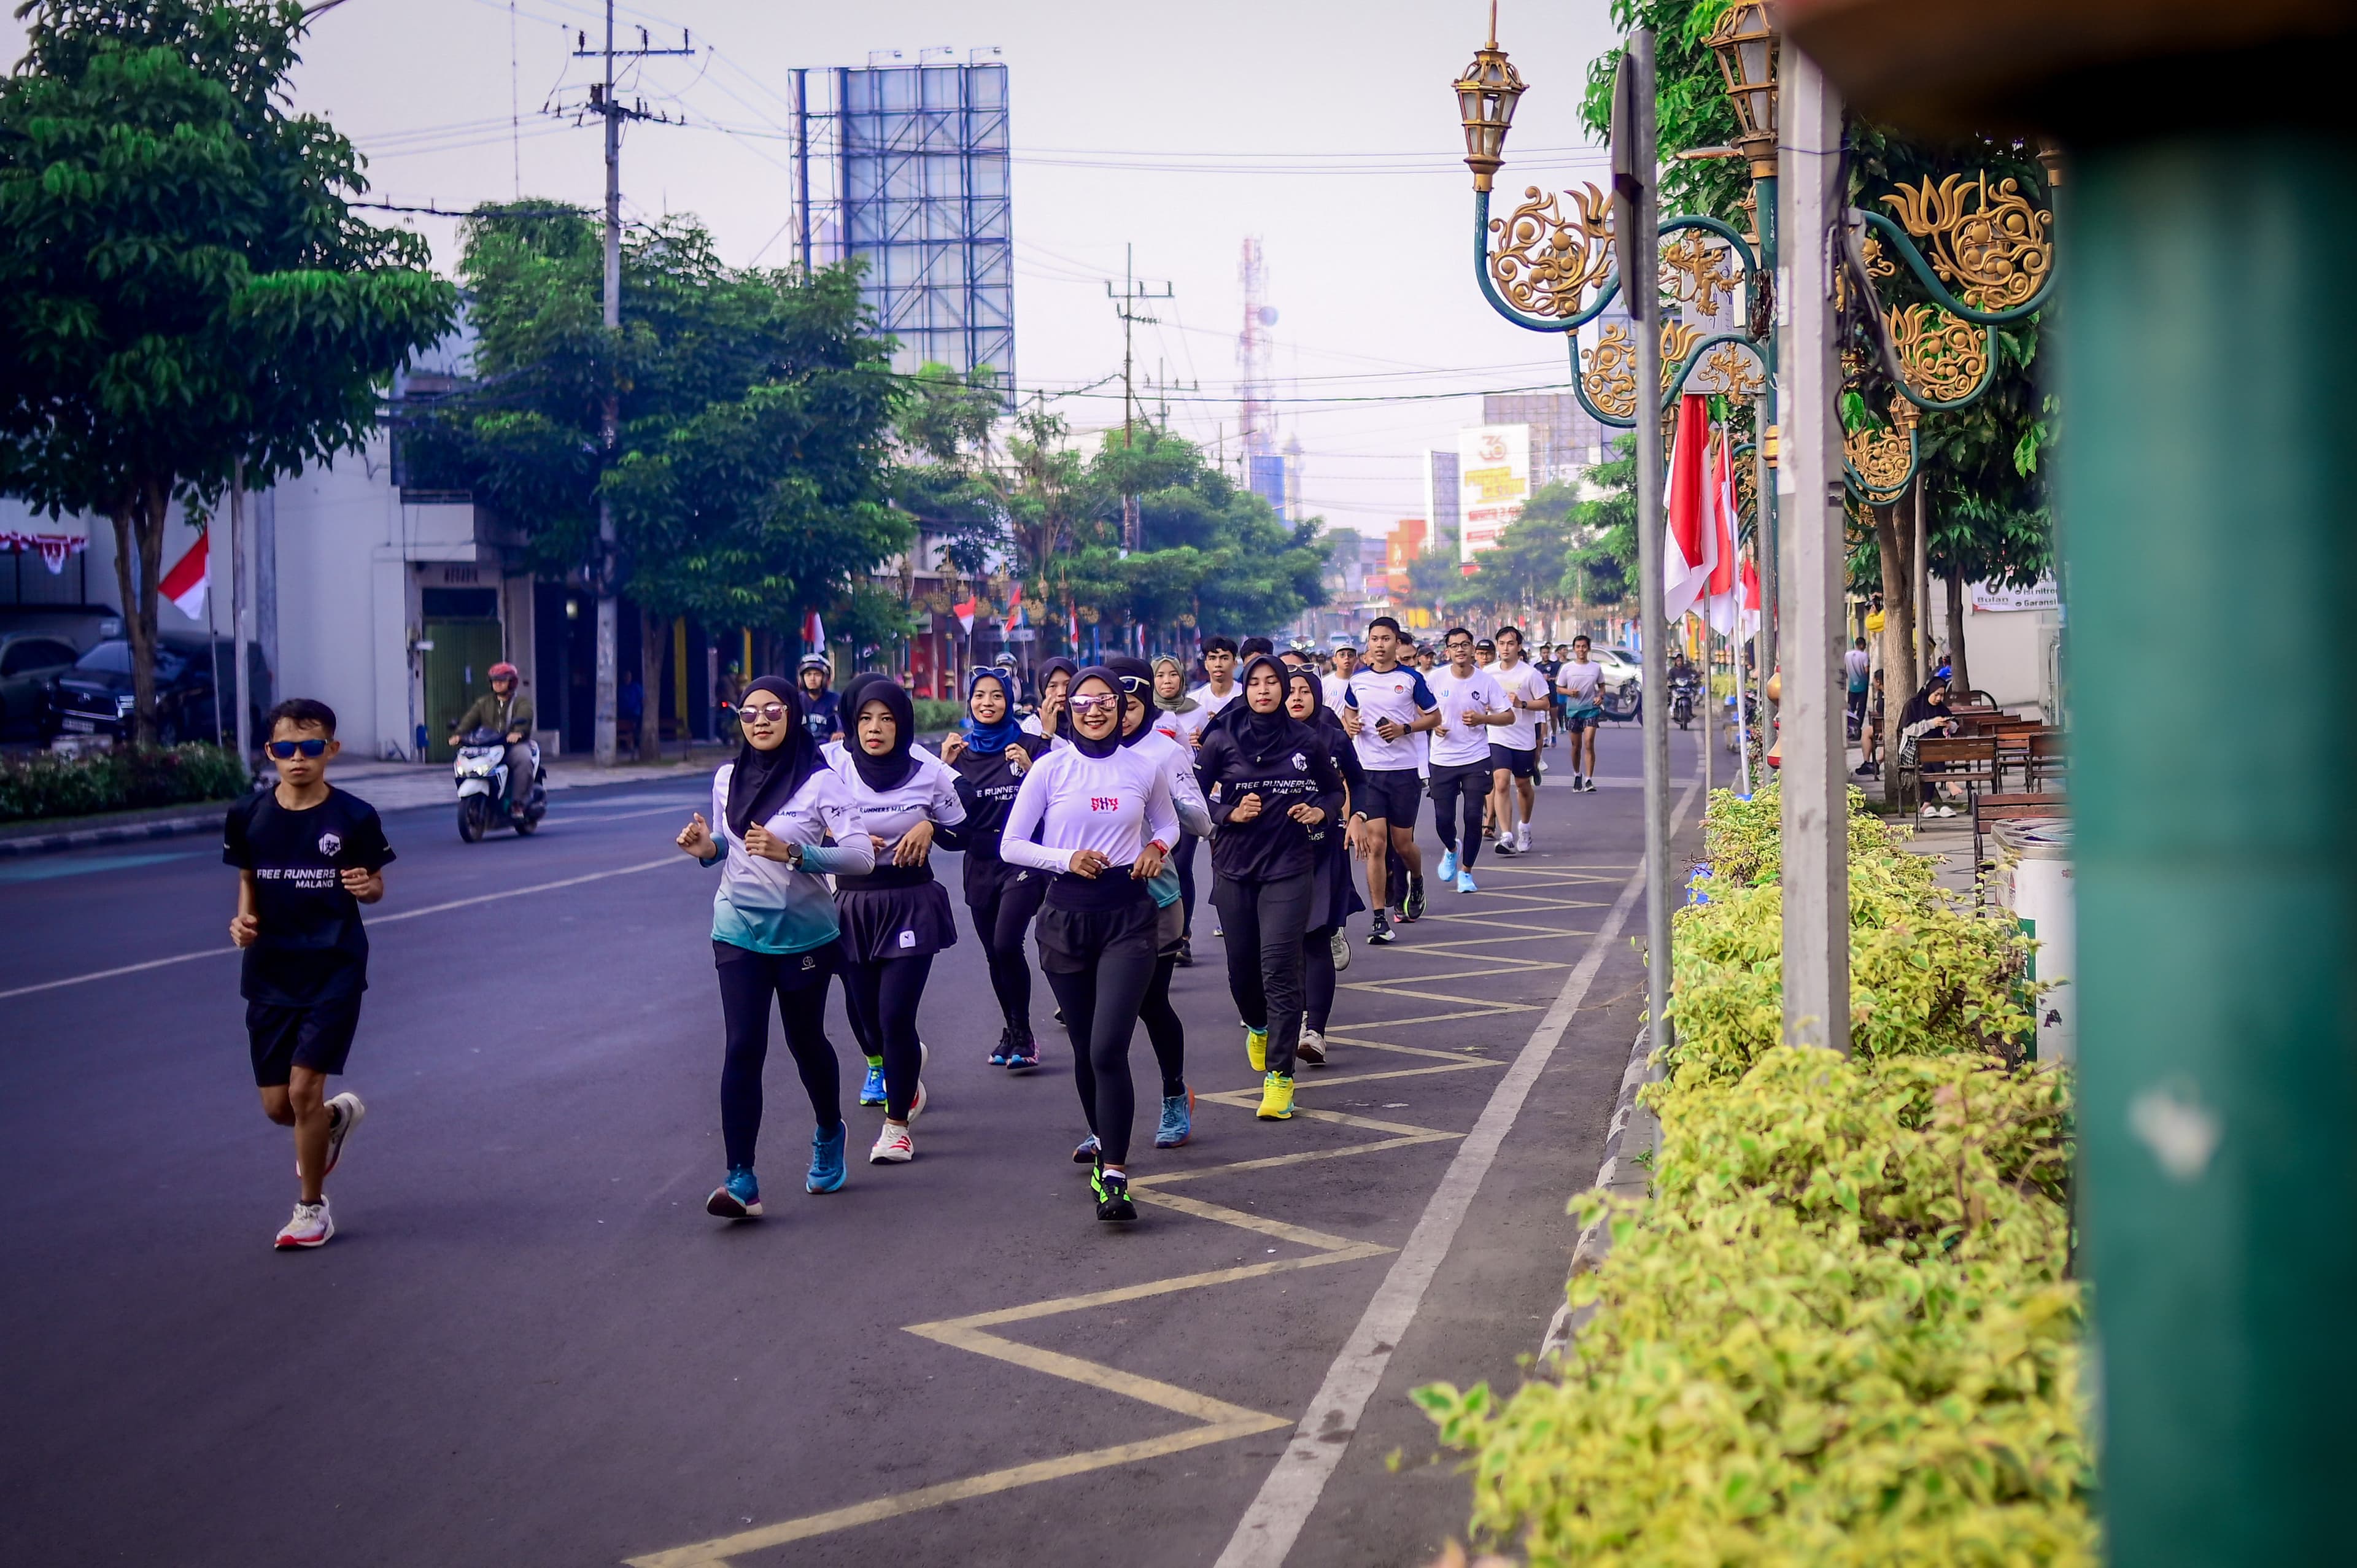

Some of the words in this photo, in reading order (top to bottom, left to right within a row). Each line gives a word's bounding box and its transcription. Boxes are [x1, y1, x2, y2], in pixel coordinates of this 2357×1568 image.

[1236, 781, 1260, 790] FREE
[1091, 797, 1118, 811] SHY
[257, 868, 281, 879] FREE
[284, 868, 336, 879] RUNNERS
[295, 879, 333, 889] MALANG
